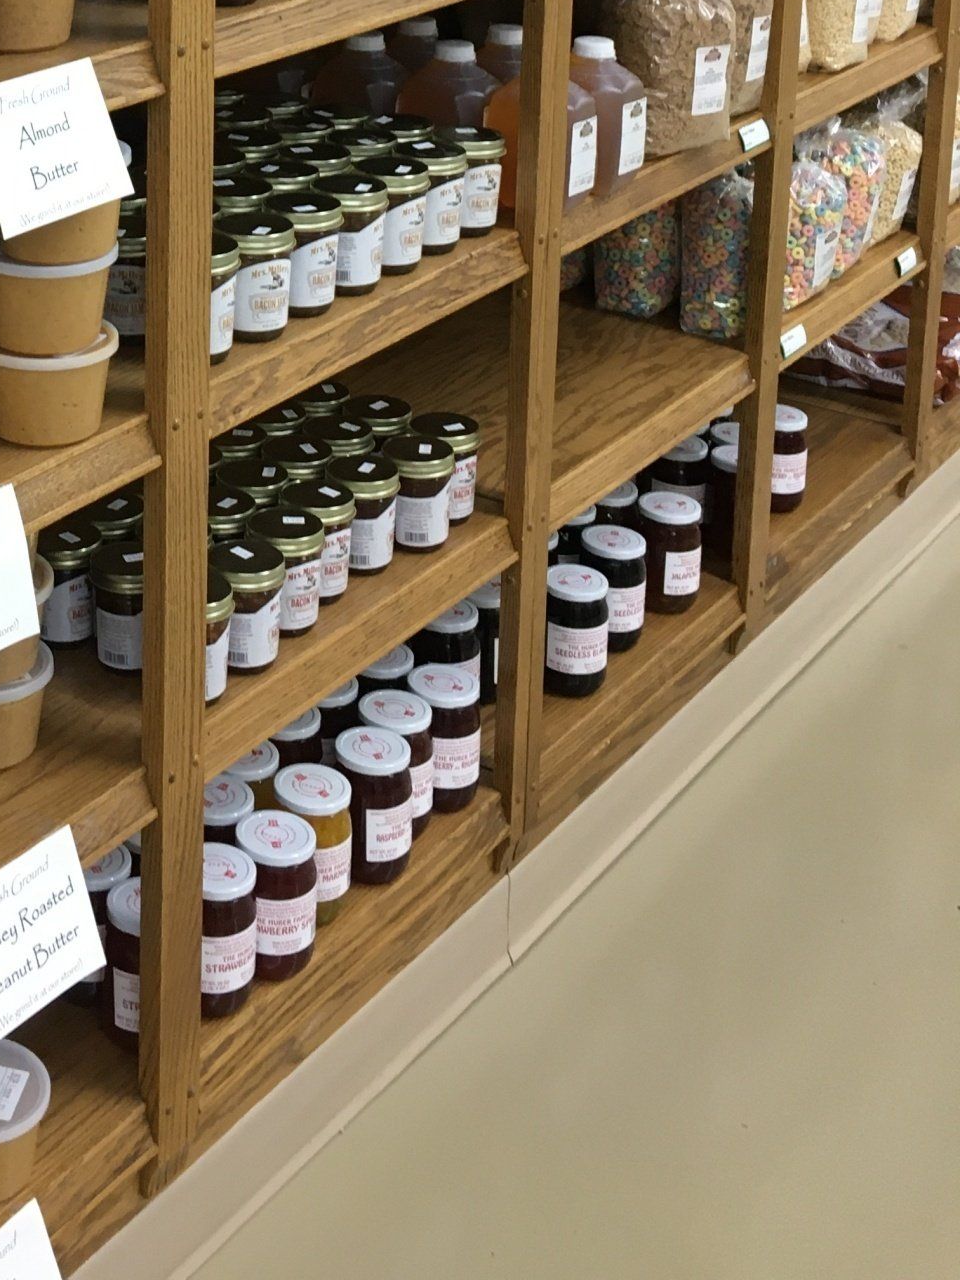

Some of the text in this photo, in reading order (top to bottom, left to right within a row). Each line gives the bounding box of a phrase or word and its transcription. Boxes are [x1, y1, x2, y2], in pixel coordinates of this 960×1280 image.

[0, 75, 71, 115] Fresh Ground
[19, 111, 71, 150] Almond
[30, 160, 79, 191] Butter
[254, 299, 276, 310] BACON
[290, 596, 311, 608] BACON
[555, 647, 591, 659] SEEDLESS
[10, 854, 49, 897] Ground
[18, 876, 75, 932] Roasted
[33, 926, 80, 969] Butter
